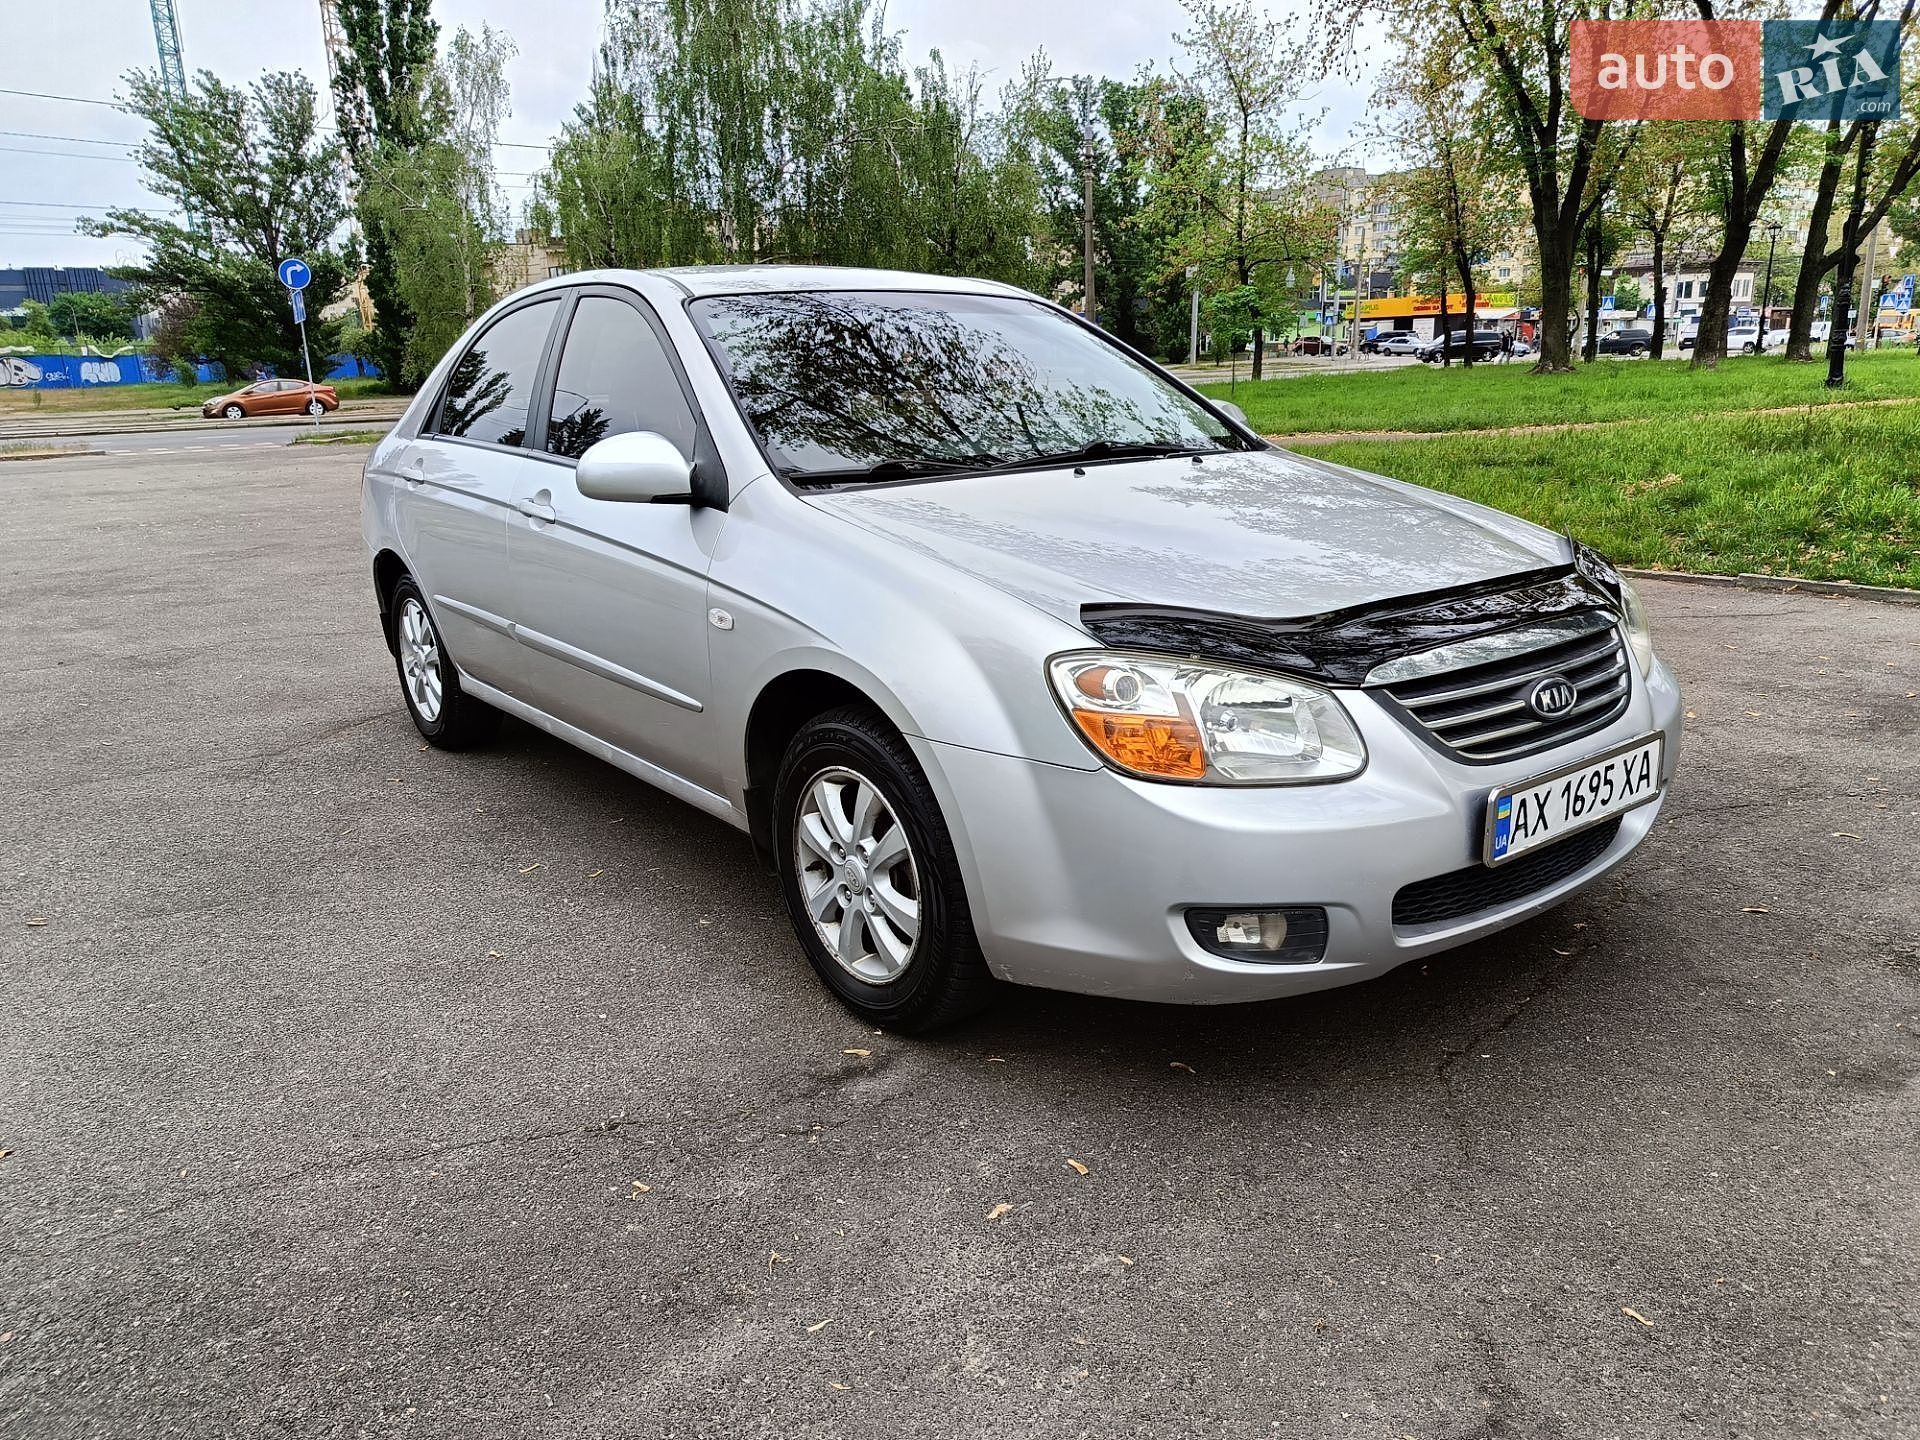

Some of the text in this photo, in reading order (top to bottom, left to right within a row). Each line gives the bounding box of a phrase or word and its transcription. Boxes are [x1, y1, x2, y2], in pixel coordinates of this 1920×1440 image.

[1538, 685, 1573, 711] KIA
[1510, 751, 1651, 844] AX 1695 XA
[1495, 836, 1508, 849] UA
